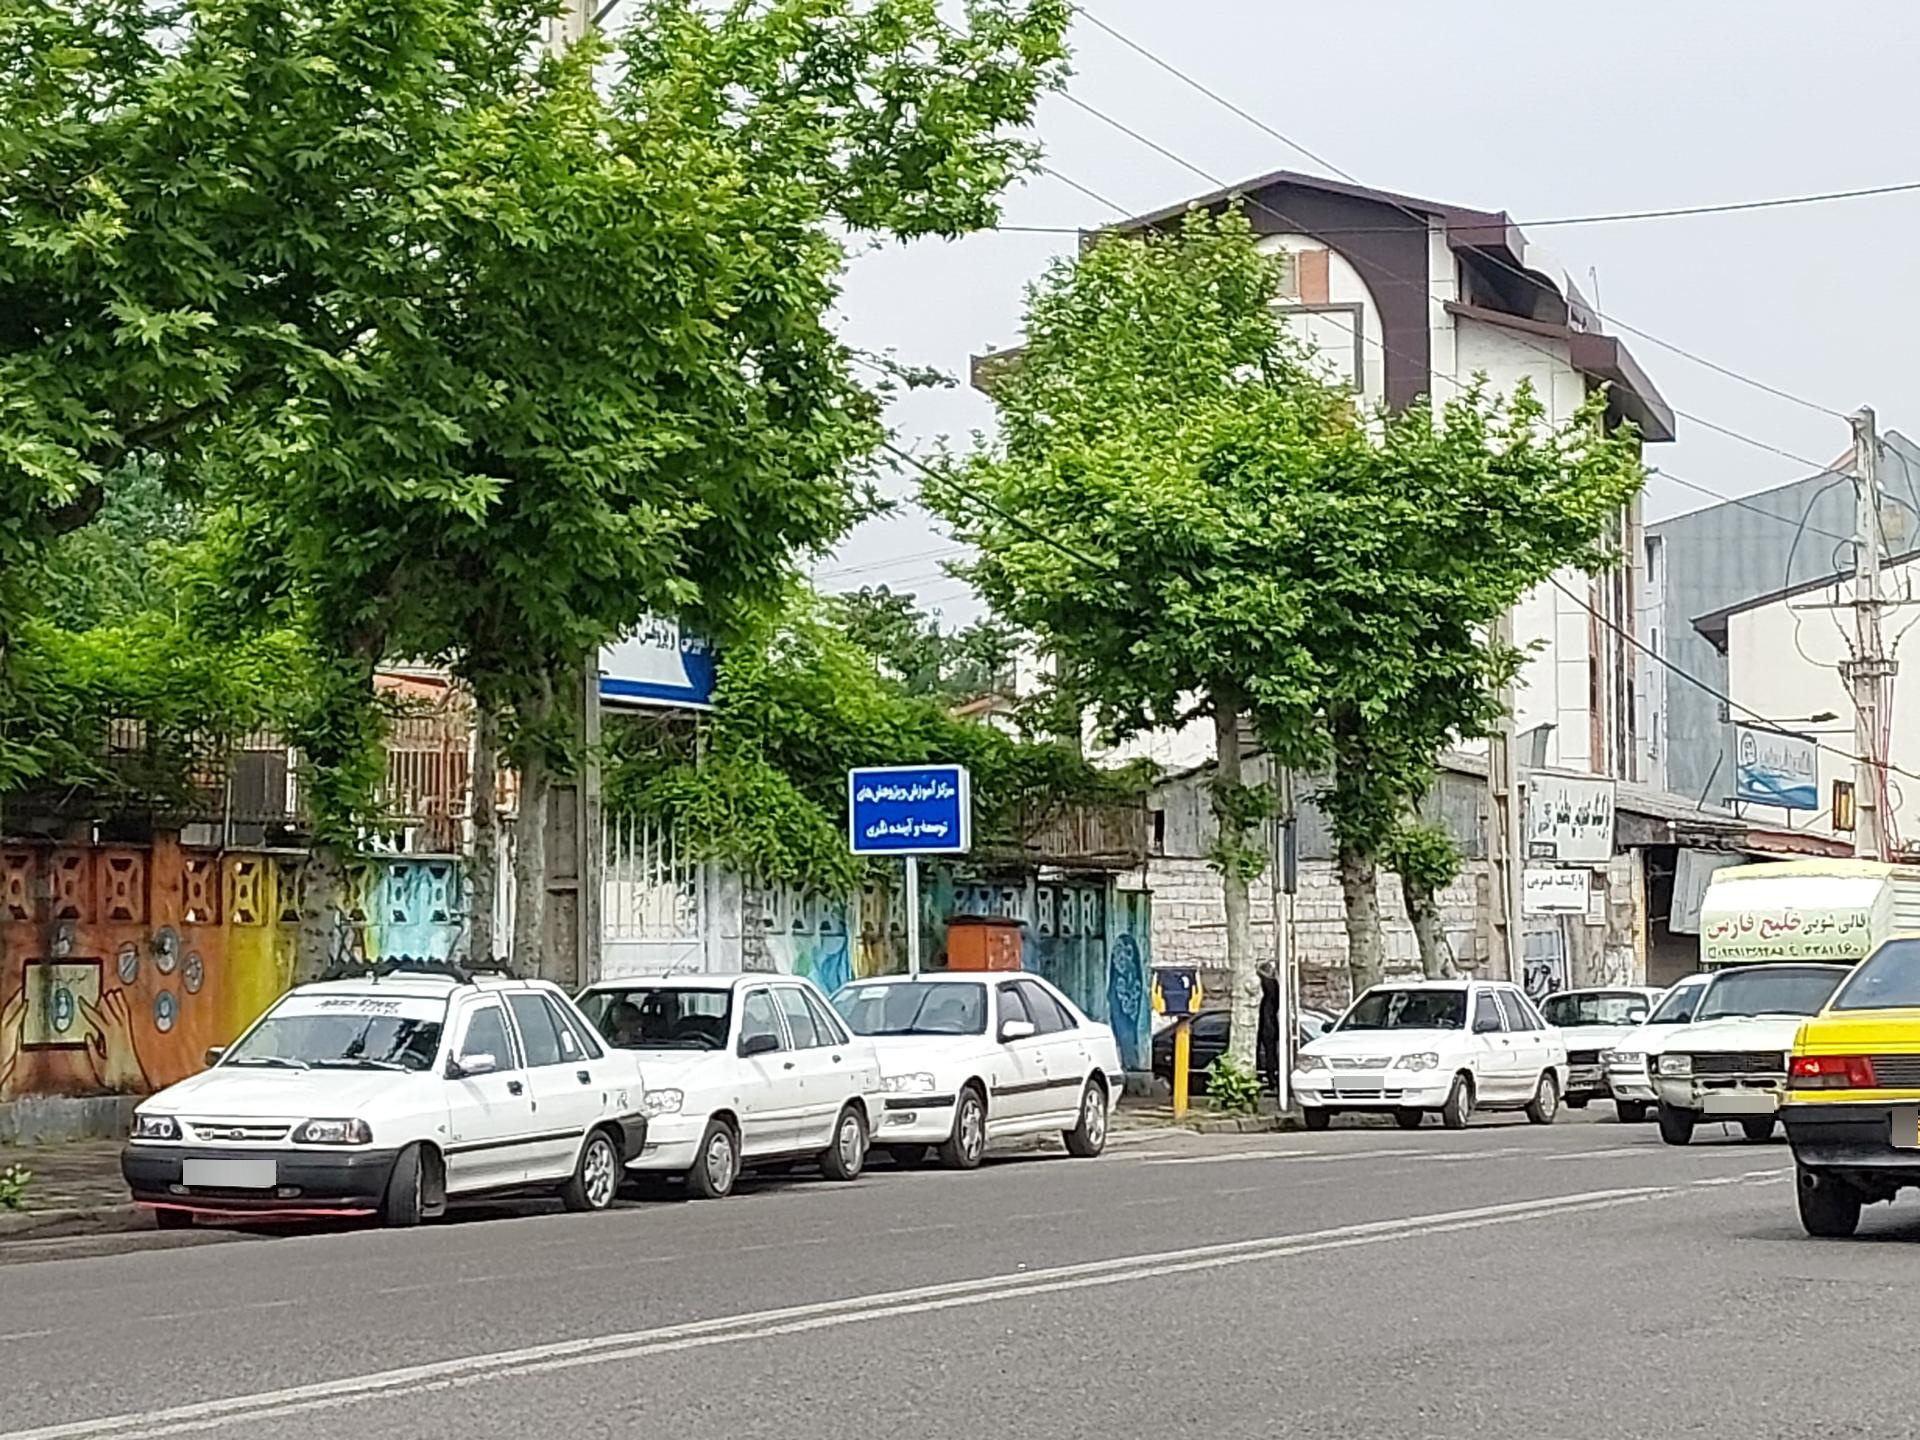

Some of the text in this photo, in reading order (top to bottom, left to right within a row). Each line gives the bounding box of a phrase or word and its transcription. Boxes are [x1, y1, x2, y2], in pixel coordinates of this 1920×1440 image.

[1707, 912, 1754, 940] فارس
[1759, 910, 1801, 939] خلیج
[1838, 911, 1866, 934] قالی
